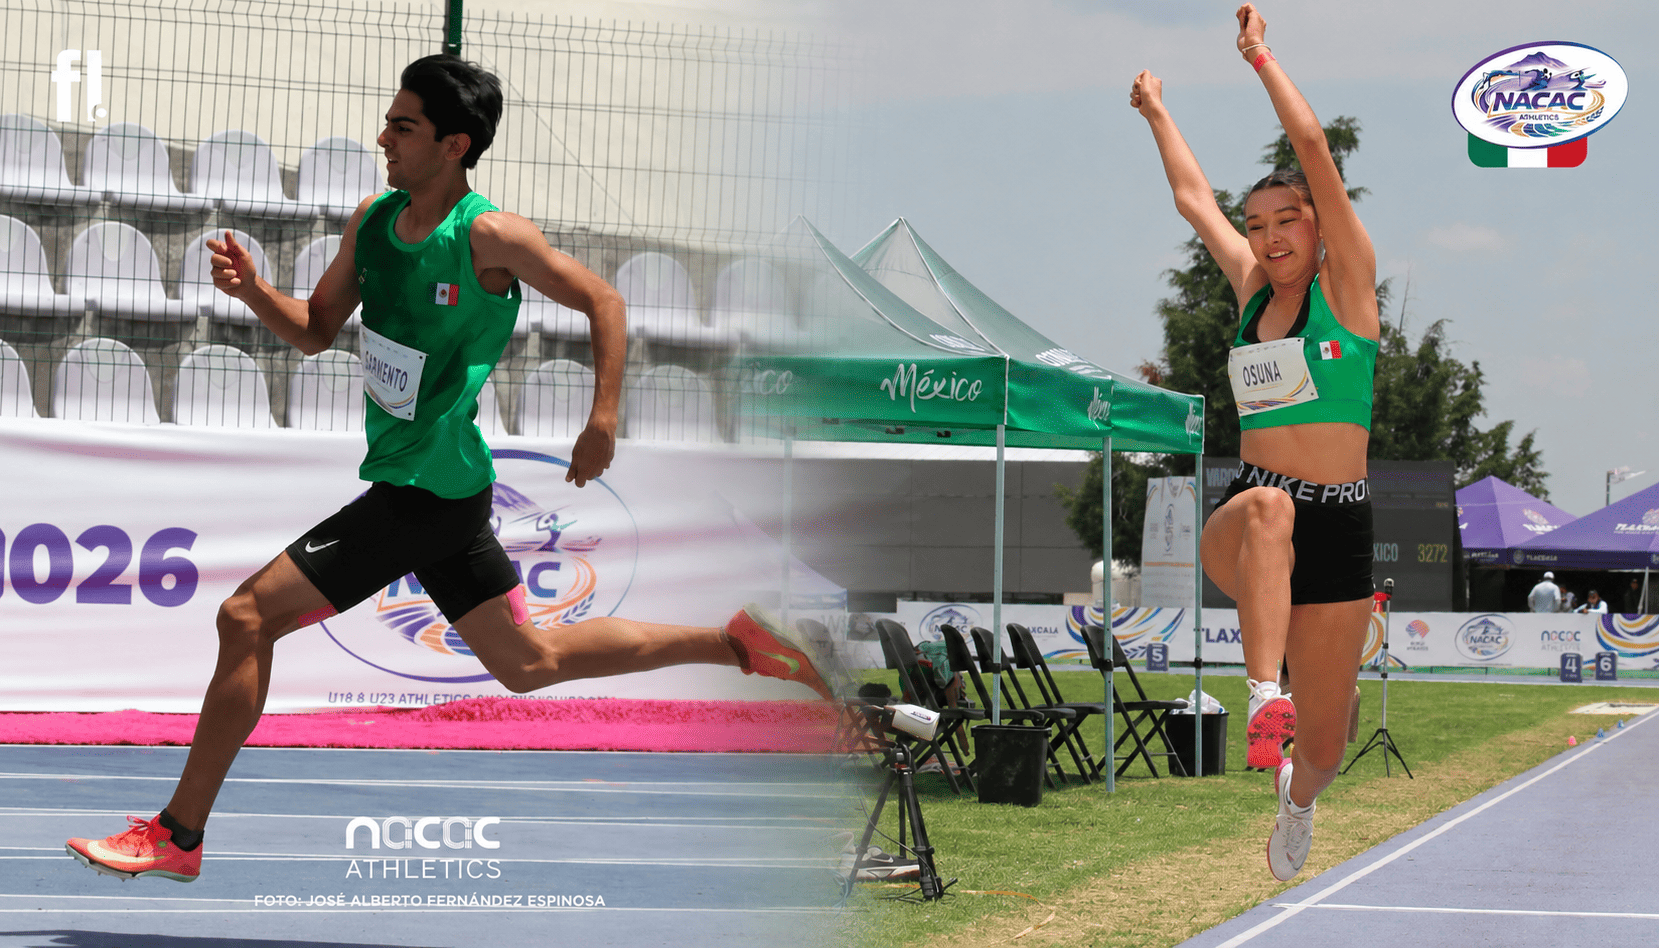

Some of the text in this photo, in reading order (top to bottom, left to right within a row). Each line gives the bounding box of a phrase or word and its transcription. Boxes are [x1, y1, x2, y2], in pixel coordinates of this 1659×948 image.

[1242, 360, 1282, 387] OSUNA
[880, 363, 983, 413] México
[1247, 466, 1318, 501] NIKE
[1321, 479, 1366, 503] PRO
[1373, 543, 1399, 562] XICO
[1418, 543, 1449, 563] 3272
[0, 522, 199, 608] 026
[1470, 635, 1502, 644] NACAC
[1151, 647, 1164, 662] 5
[1564, 658, 1578, 673] 4
[1600, 657, 1613, 672] 6
[328, 692, 353, 704] U18
[369, 693, 396, 704] U23
